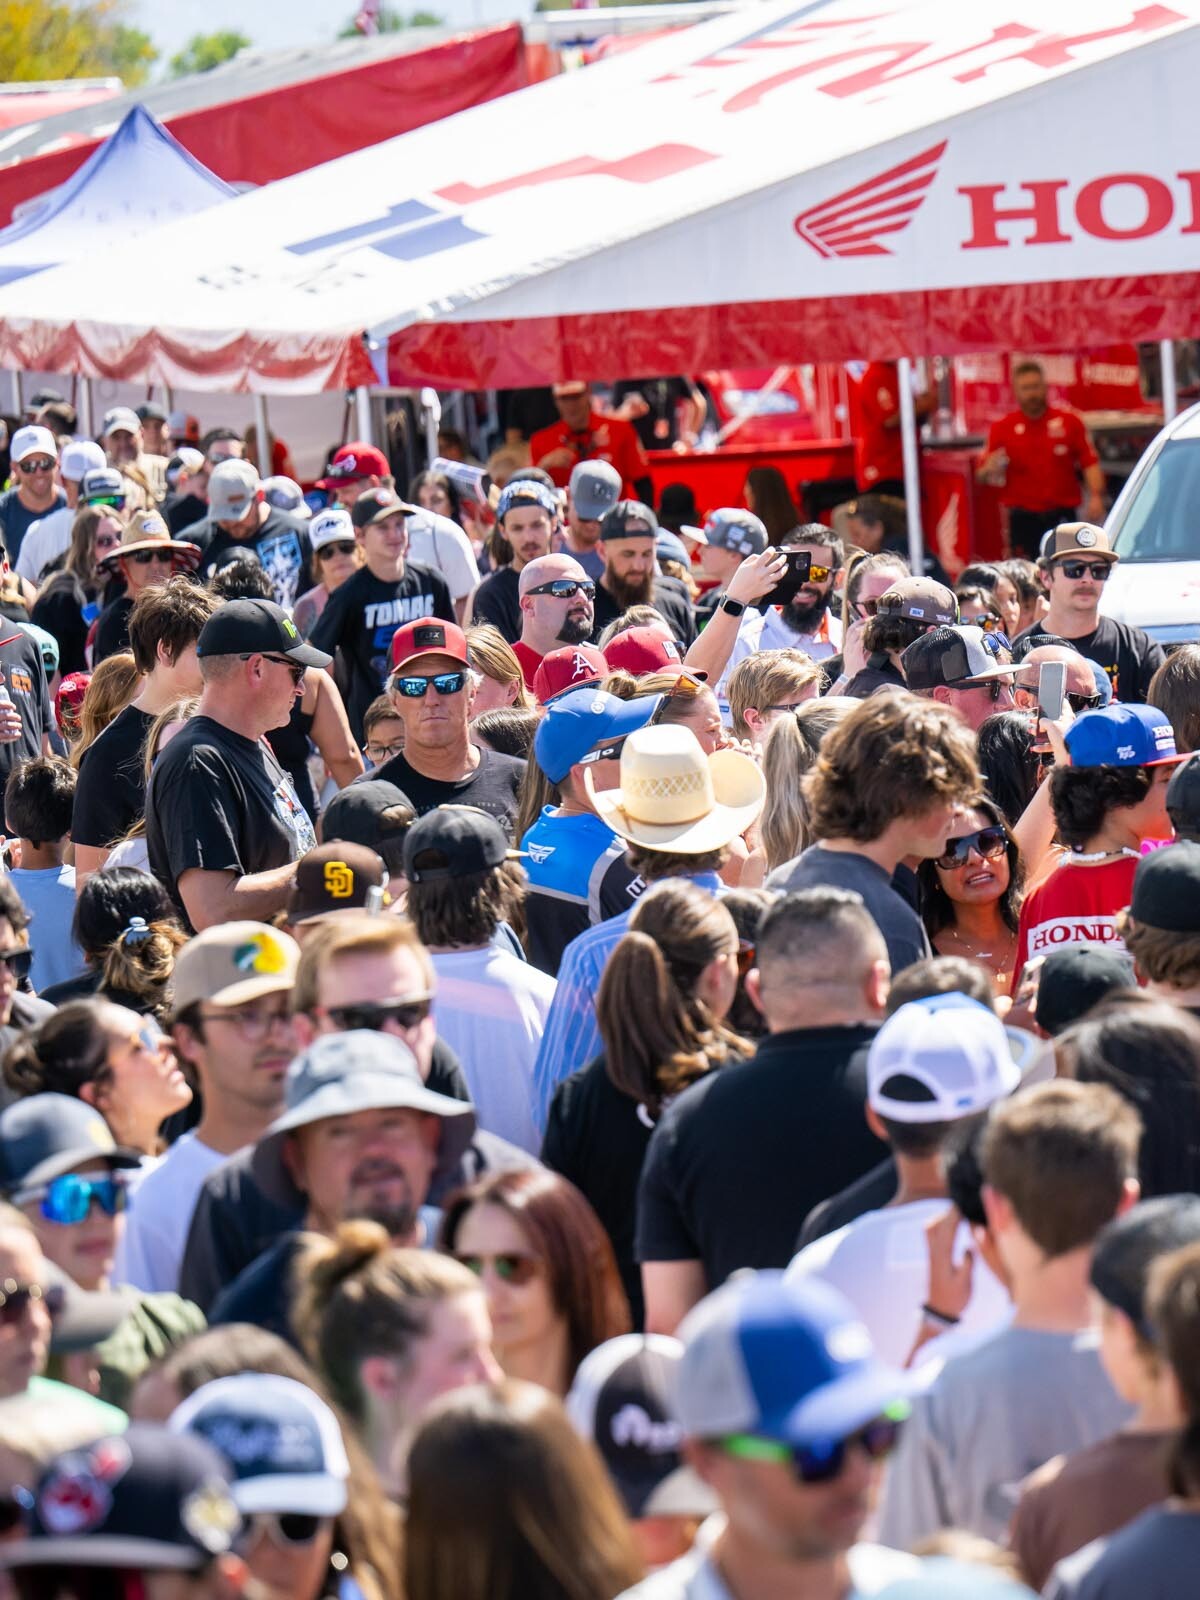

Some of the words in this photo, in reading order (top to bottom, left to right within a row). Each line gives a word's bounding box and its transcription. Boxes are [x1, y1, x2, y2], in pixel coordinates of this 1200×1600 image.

[572, 651, 598, 680] A
[324, 861, 354, 898] SD
[1033, 923, 1122, 950] HOND
